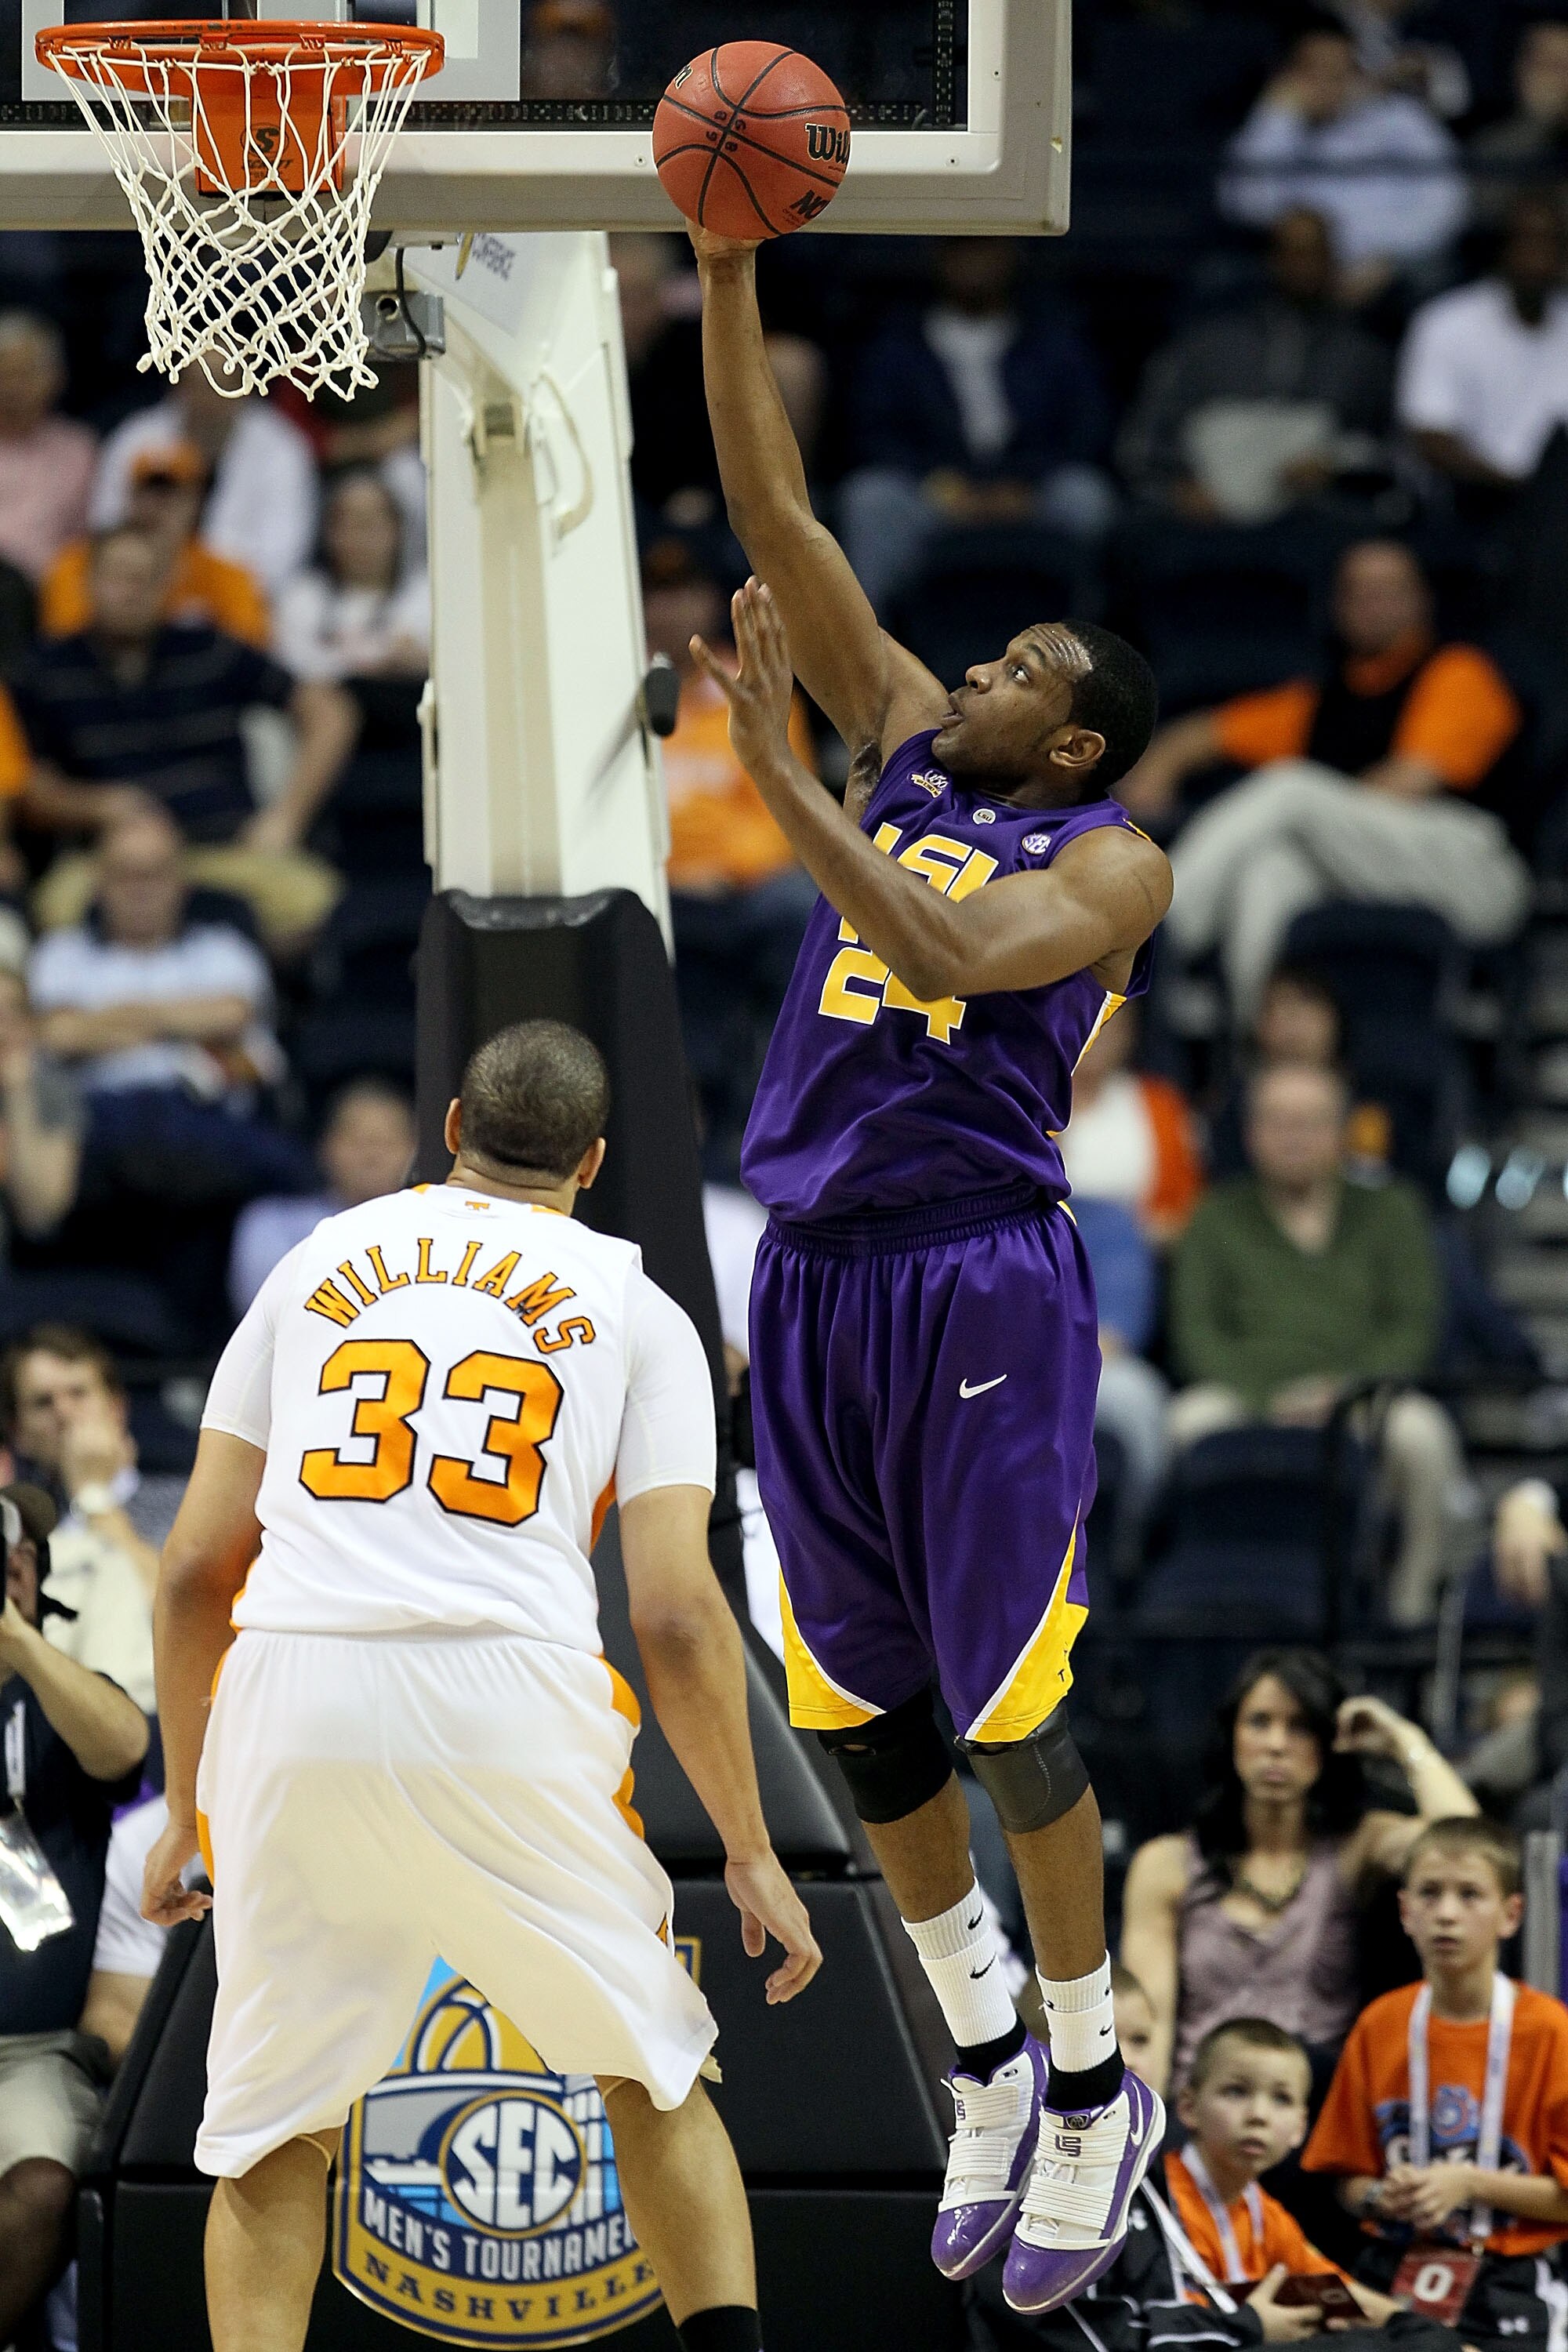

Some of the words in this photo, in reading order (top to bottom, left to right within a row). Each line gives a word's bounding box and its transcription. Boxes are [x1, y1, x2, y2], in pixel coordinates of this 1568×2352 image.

[804, 122, 851, 165] Wil
[977, 811, 993, 822] LSU
[1023, 833, 1052, 854] SEC
[818, 946, 967, 1045] 24
[304, 1237, 596, 1355] WILLIAMS
[299, 1339, 564, 1526] 33
[449, 2097, 580, 2230] SEC
[364, 2187, 451, 2270] MEN'S
